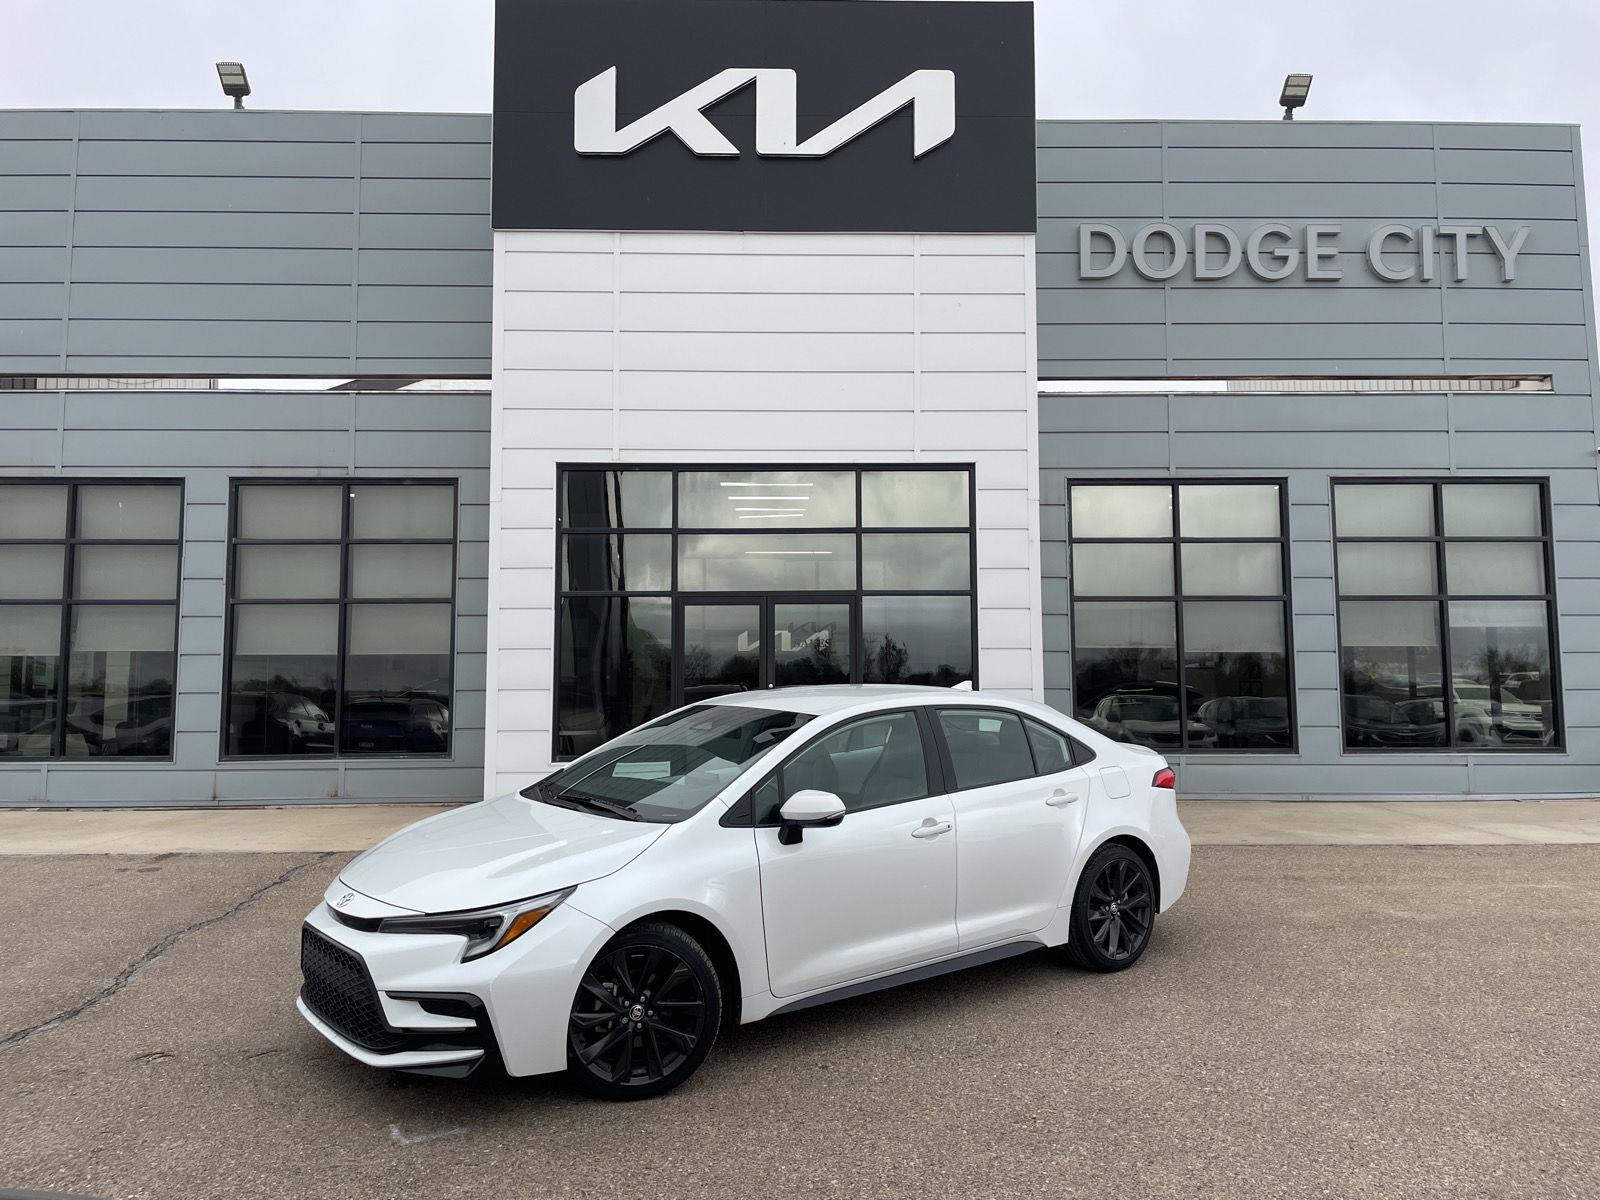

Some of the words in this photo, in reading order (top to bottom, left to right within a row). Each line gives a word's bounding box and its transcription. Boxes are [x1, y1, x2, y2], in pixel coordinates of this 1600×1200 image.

[574, 65, 956, 160] KIA
[1079, 222, 1344, 282] DODGE
[1367, 223, 1532, 283] CITY
